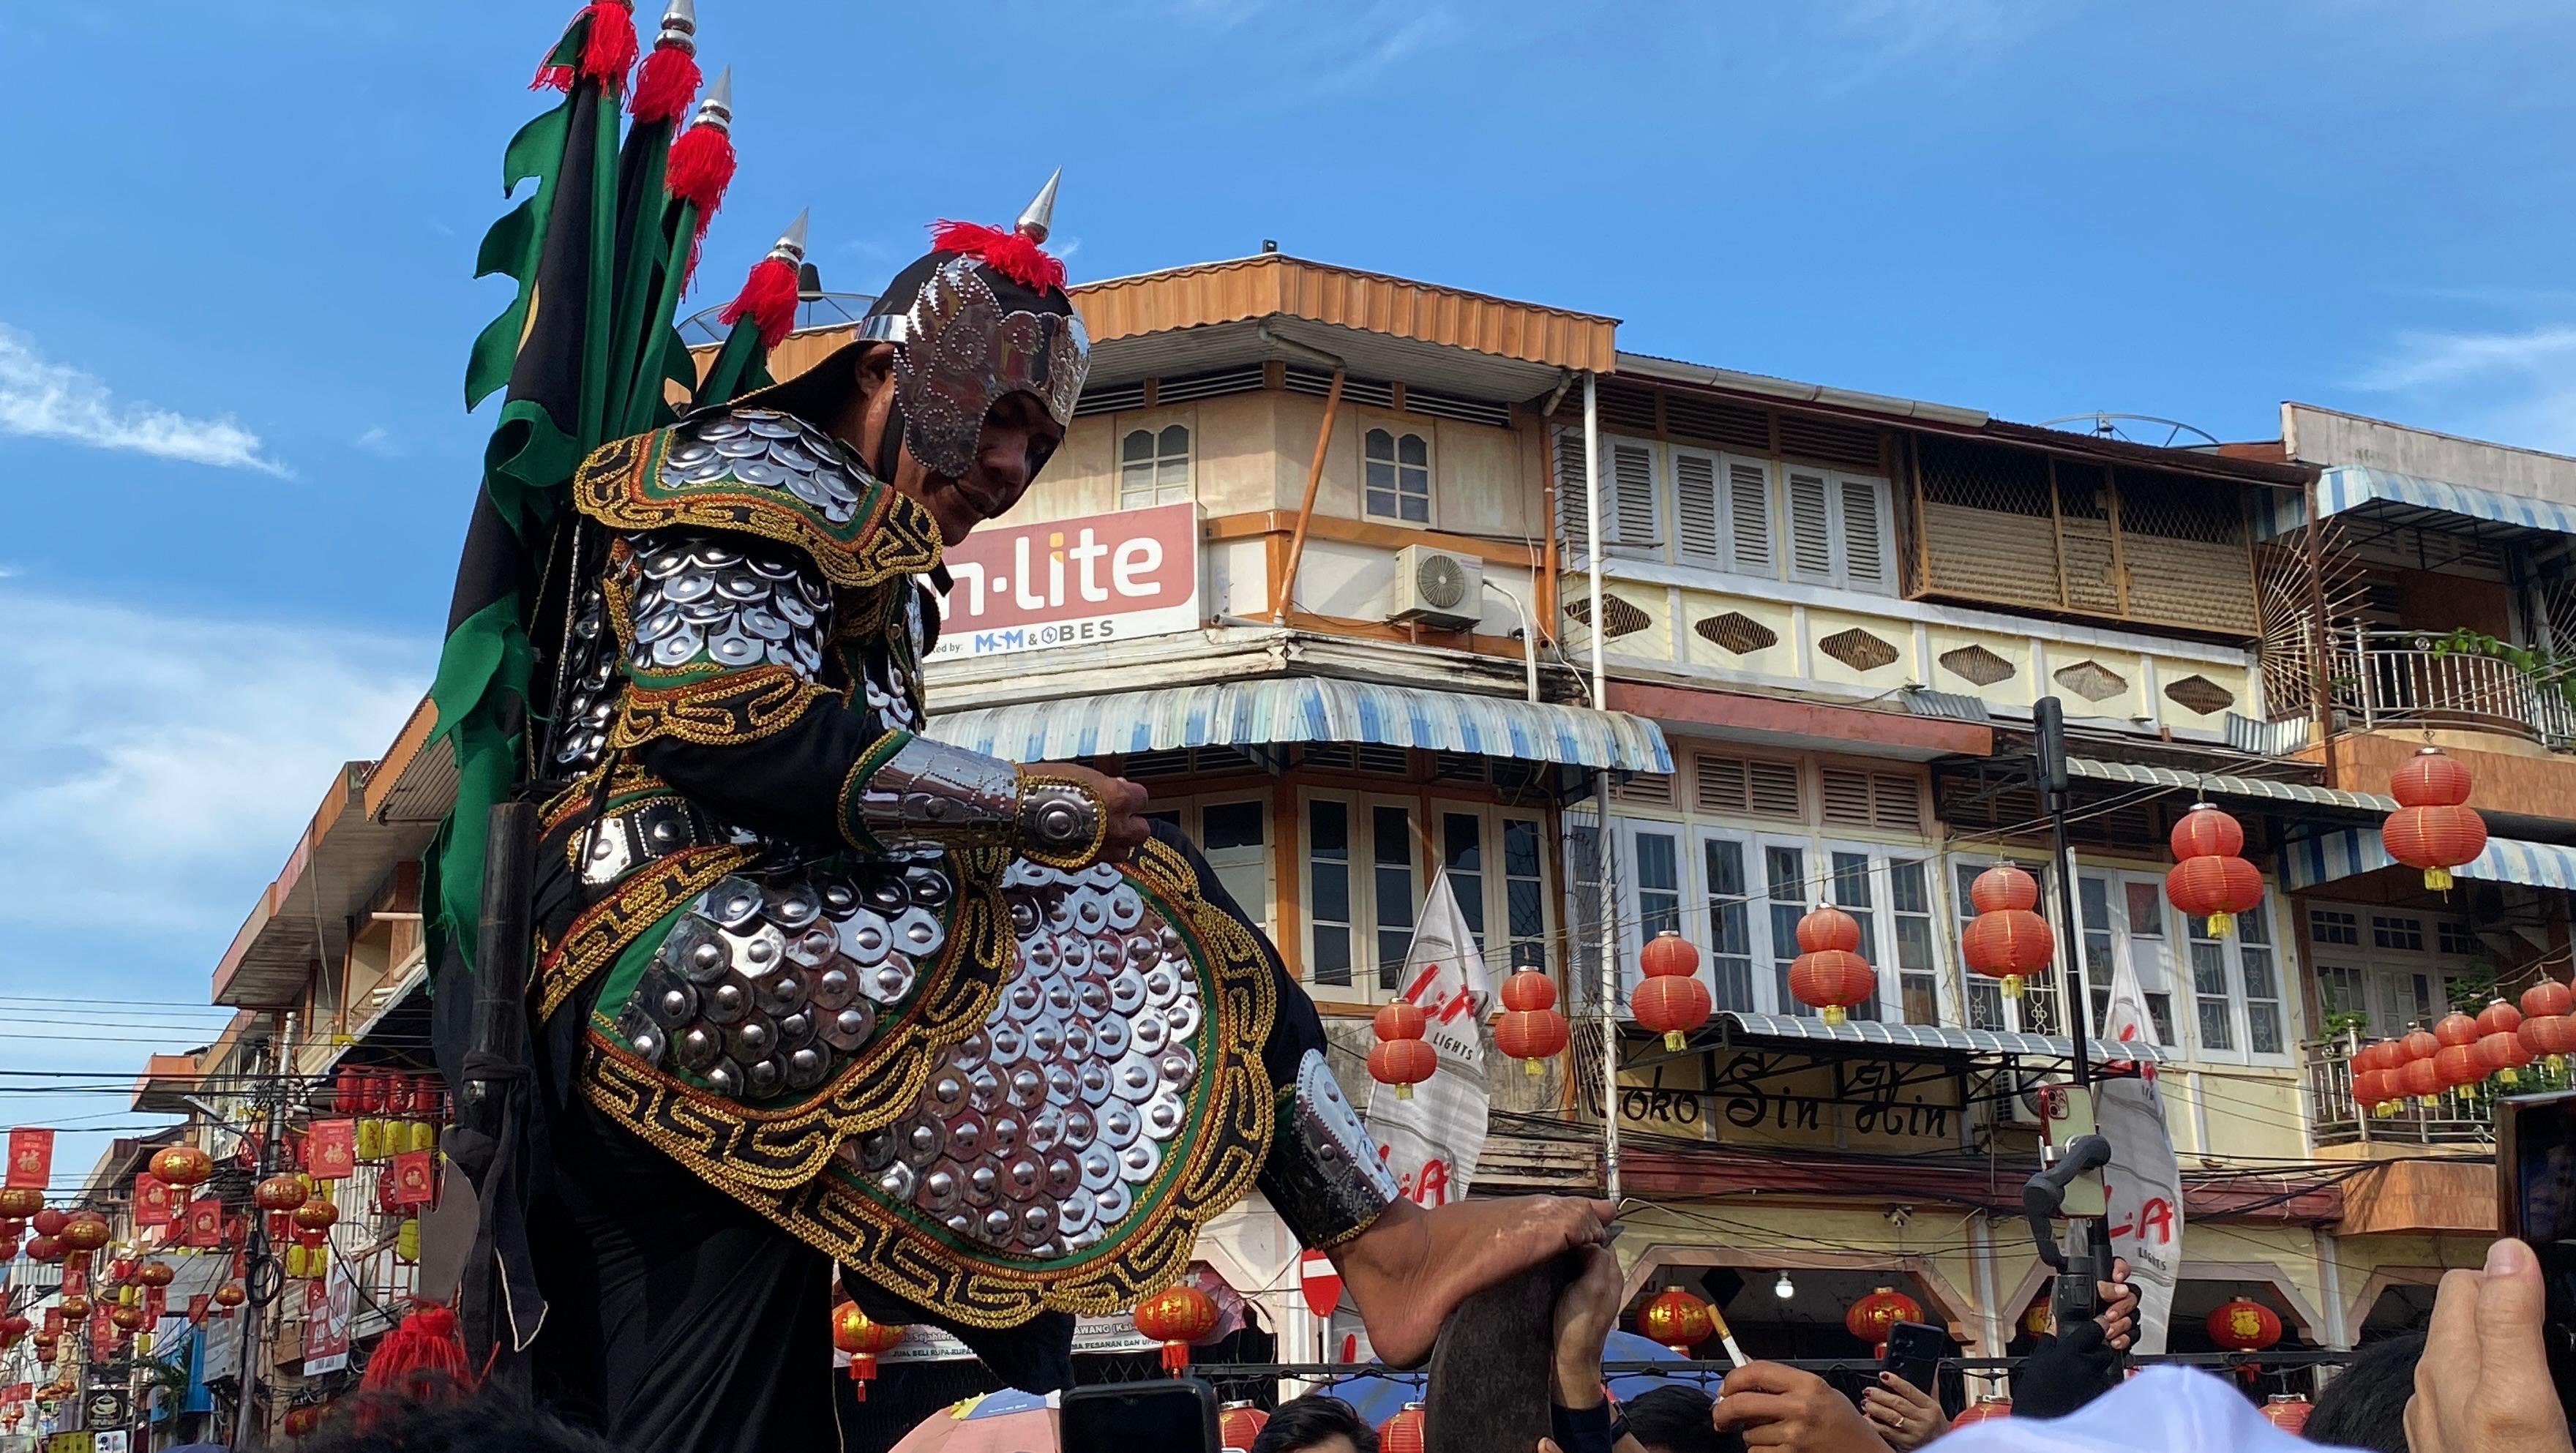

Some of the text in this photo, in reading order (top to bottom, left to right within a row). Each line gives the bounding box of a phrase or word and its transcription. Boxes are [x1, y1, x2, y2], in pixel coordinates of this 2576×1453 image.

[976, 628, 1024, 653] MSM
[1027, 633, 1038, 645] &
[1432, 1032, 1474, 1061] LIGHTS
[1725, 1057, 1819, 1130] Sin
